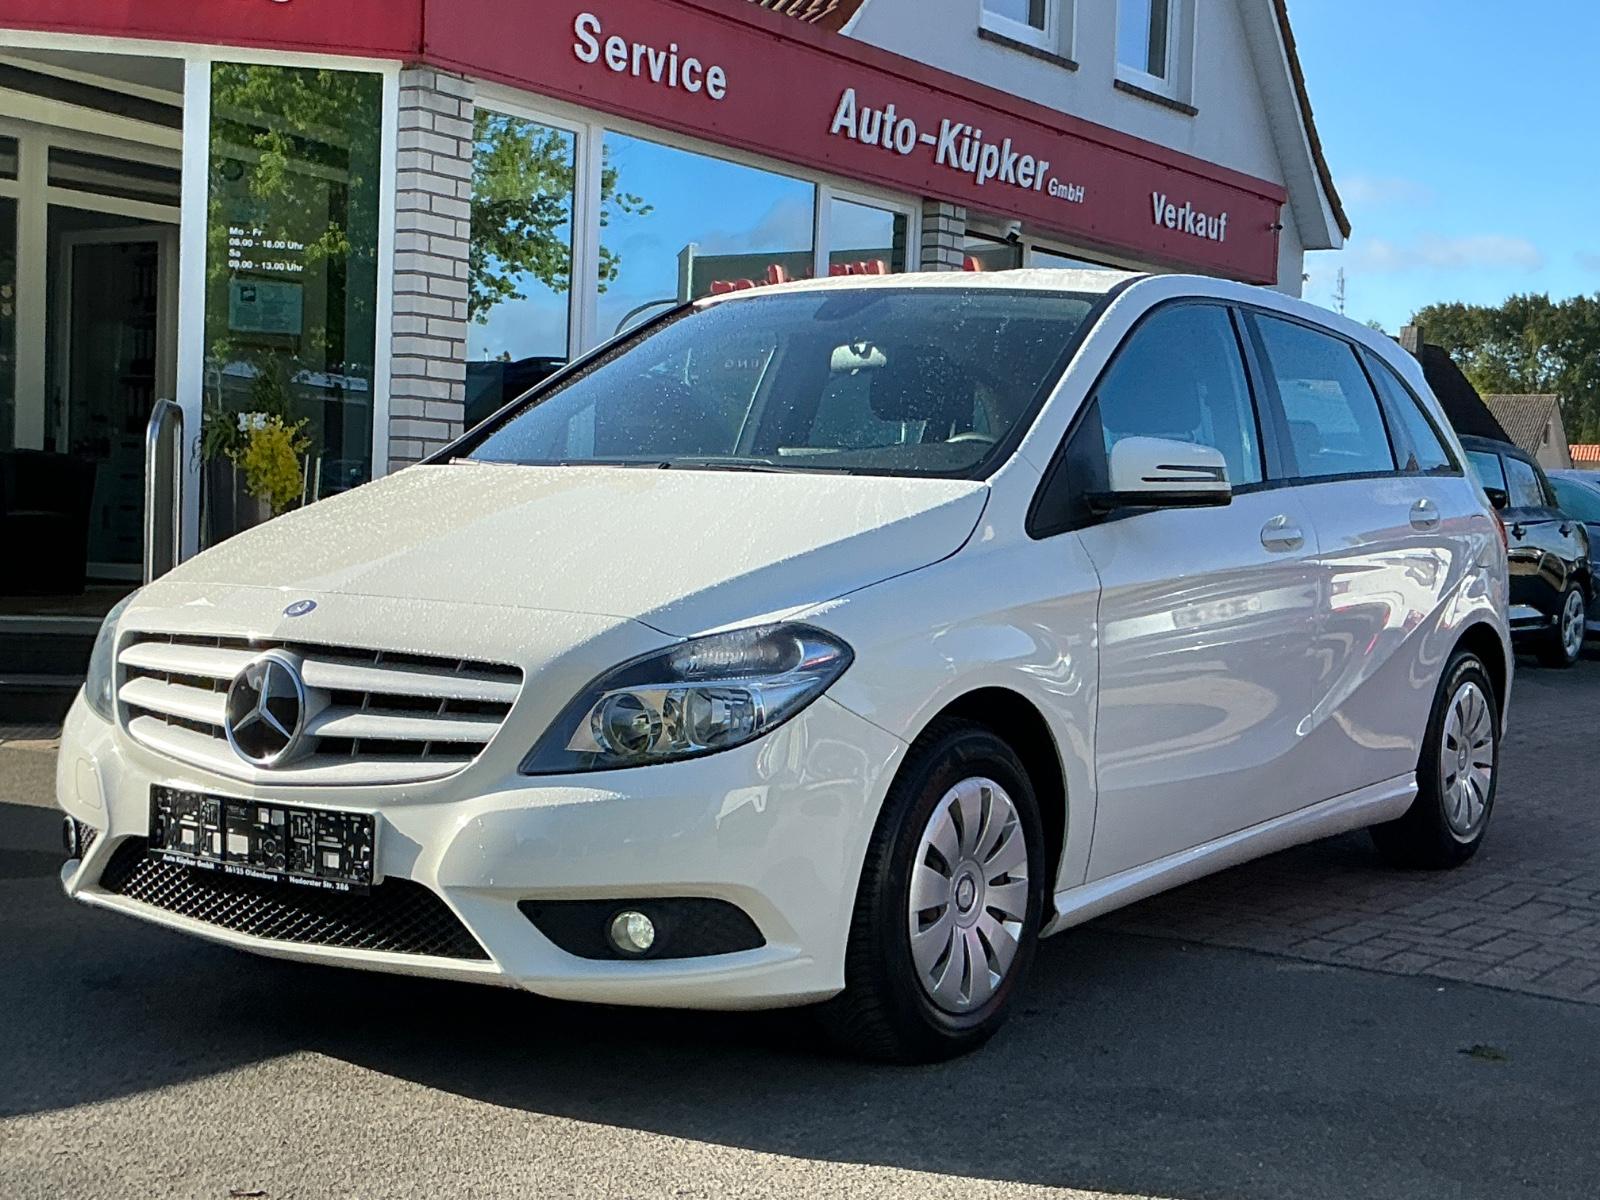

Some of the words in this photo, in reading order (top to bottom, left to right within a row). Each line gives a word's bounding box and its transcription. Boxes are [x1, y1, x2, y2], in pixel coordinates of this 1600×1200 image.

[573, 12, 727, 100] Service
[830, 87, 1050, 191] Auto-Küpker
[1048, 178, 1085, 204] GmbH
[1151, 191, 1228, 242] Verkauf
[229, 227, 244, 236] Mo
[253, 228, 263, 237] Fr
[287, 241, 304, 250] Uhr
[229, 248, 242, 258] Sa
[262, 262, 285, 271] 13.00
[287, 263, 304, 272] Uhr
[245, 869, 278, 882] Oldenburg
